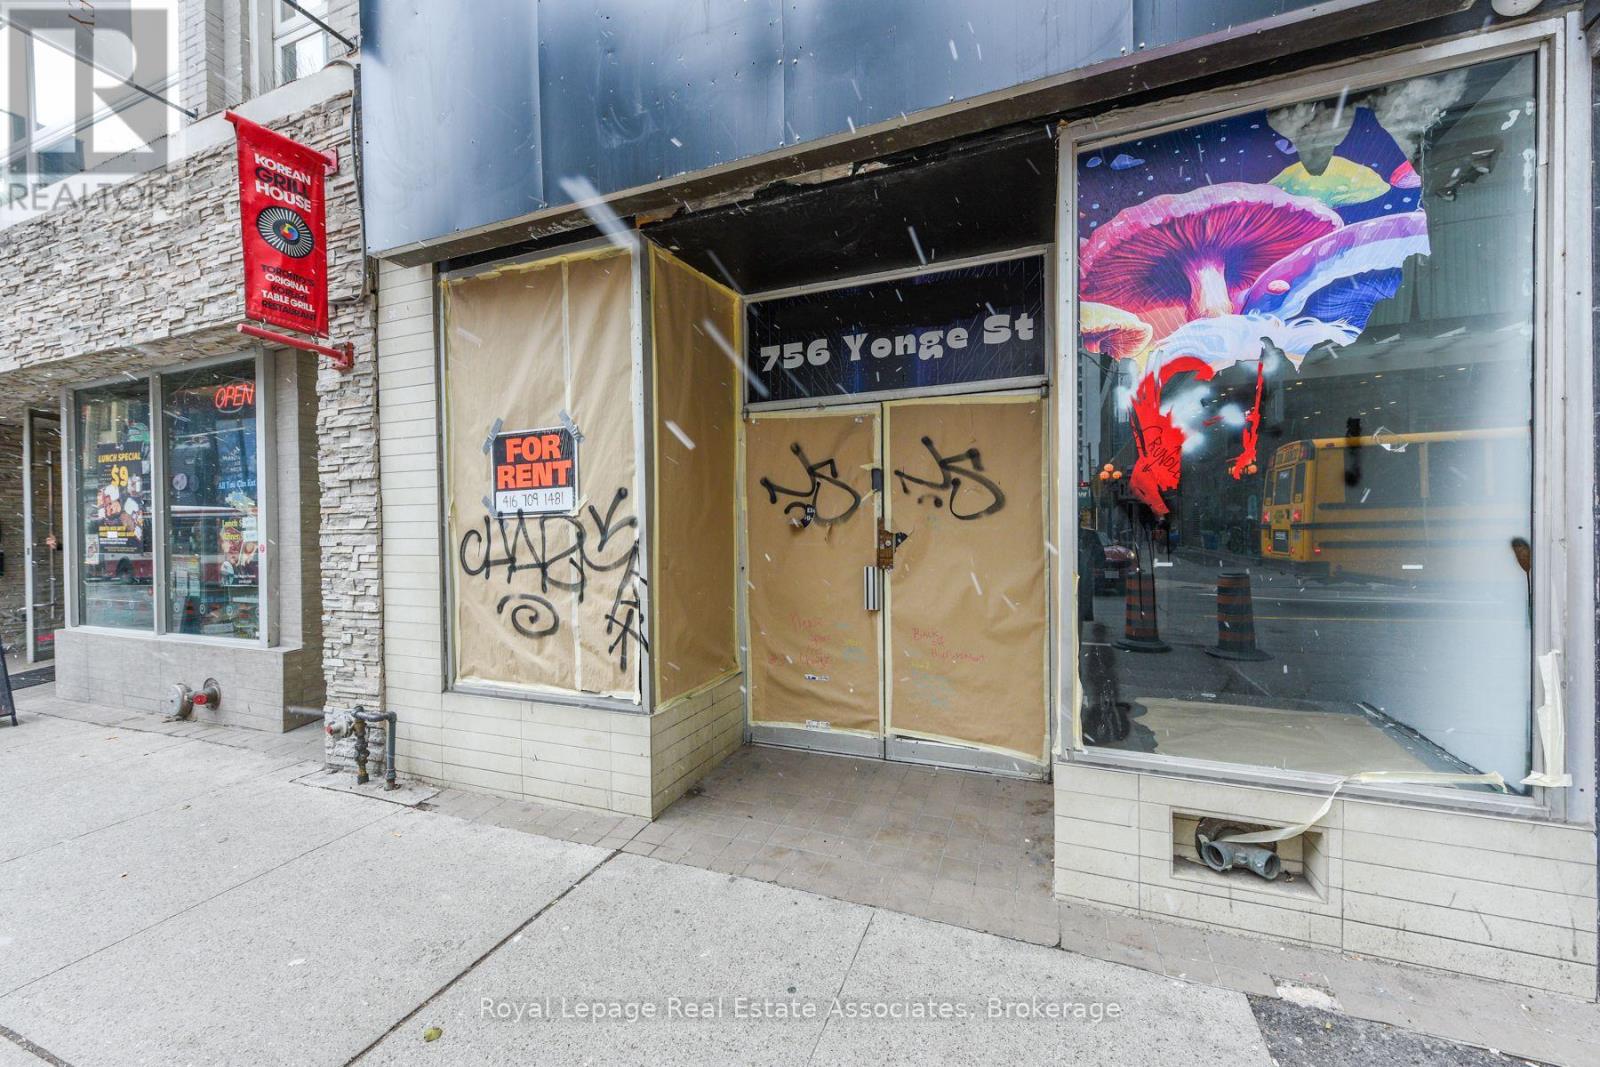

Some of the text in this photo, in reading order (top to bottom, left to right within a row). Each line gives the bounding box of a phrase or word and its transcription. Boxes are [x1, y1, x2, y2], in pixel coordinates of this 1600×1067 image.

[254, 152, 312, 186] KOREAN
[255, 166, 309, 200] GRILL
[255, 179, 312, 213] HOUSE
[264, 273, 311, 294] ORIGINAL
[261, 289, 316, 313] TABLE GRILL
[760, 313, 1034, 372] 756 Yonge St
[214, 383, 254, 409] OPEN
[98, 451, 141, 463] LUNCH SPECIAL
[506, 434, 561, 463] FOR
[111, 464, 128, 487] $9
[497, 460, 572, 490] RENT
[502, 491, 564, 509] 416 709 1481
